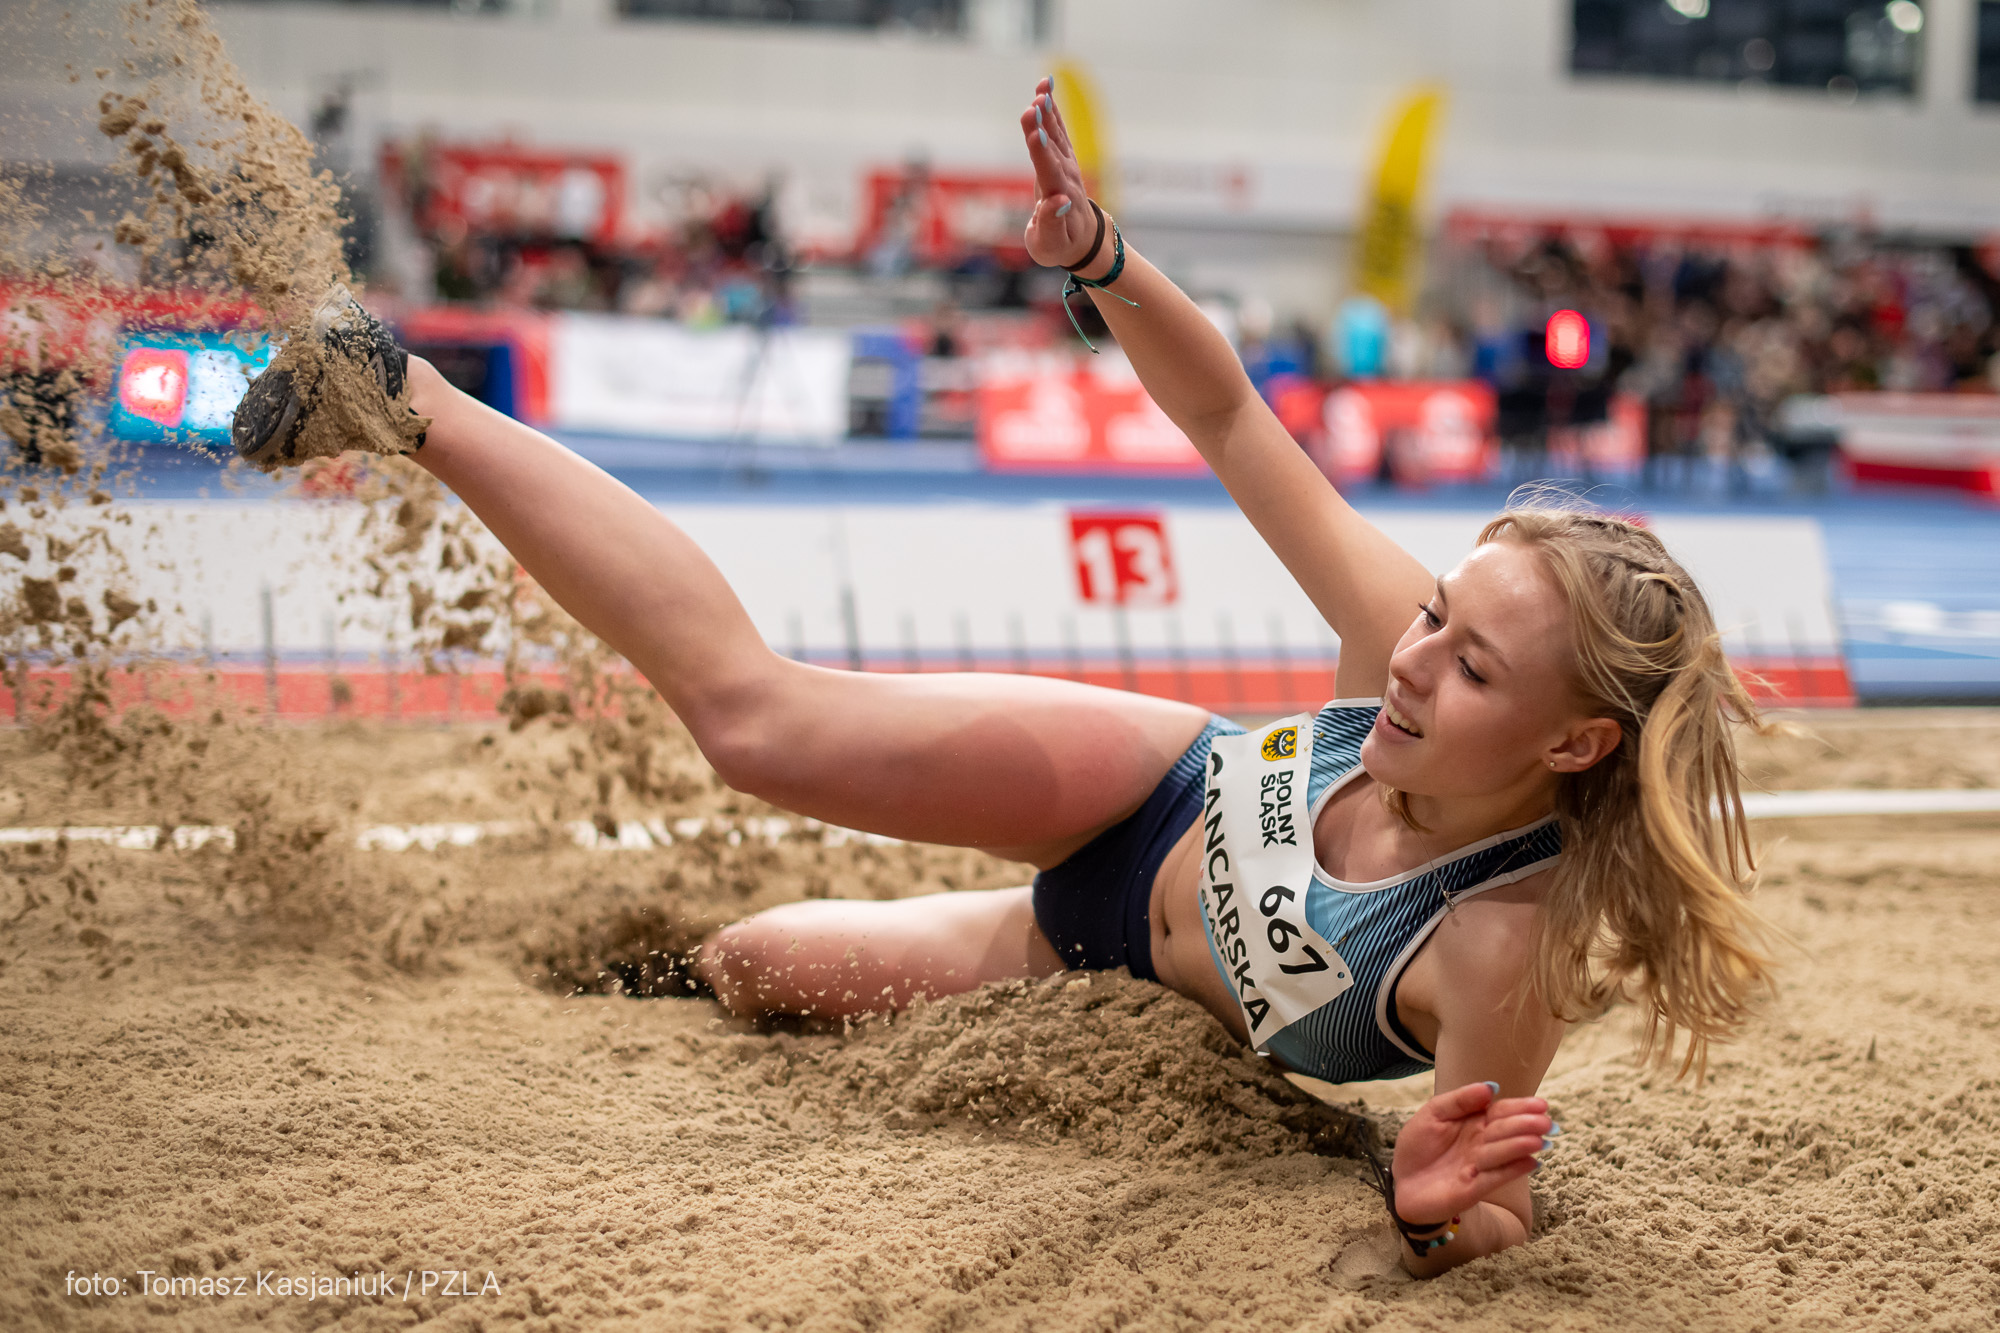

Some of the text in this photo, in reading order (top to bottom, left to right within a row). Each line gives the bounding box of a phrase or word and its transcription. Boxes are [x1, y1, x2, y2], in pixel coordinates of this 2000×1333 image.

[1075, 525, 1172, 604] 13
[1259, 773, 1279, 849] ŚLĄSK
[1276, 770, 1297, 847] DOLNY
[1259, 885, 1330, 975] 667
